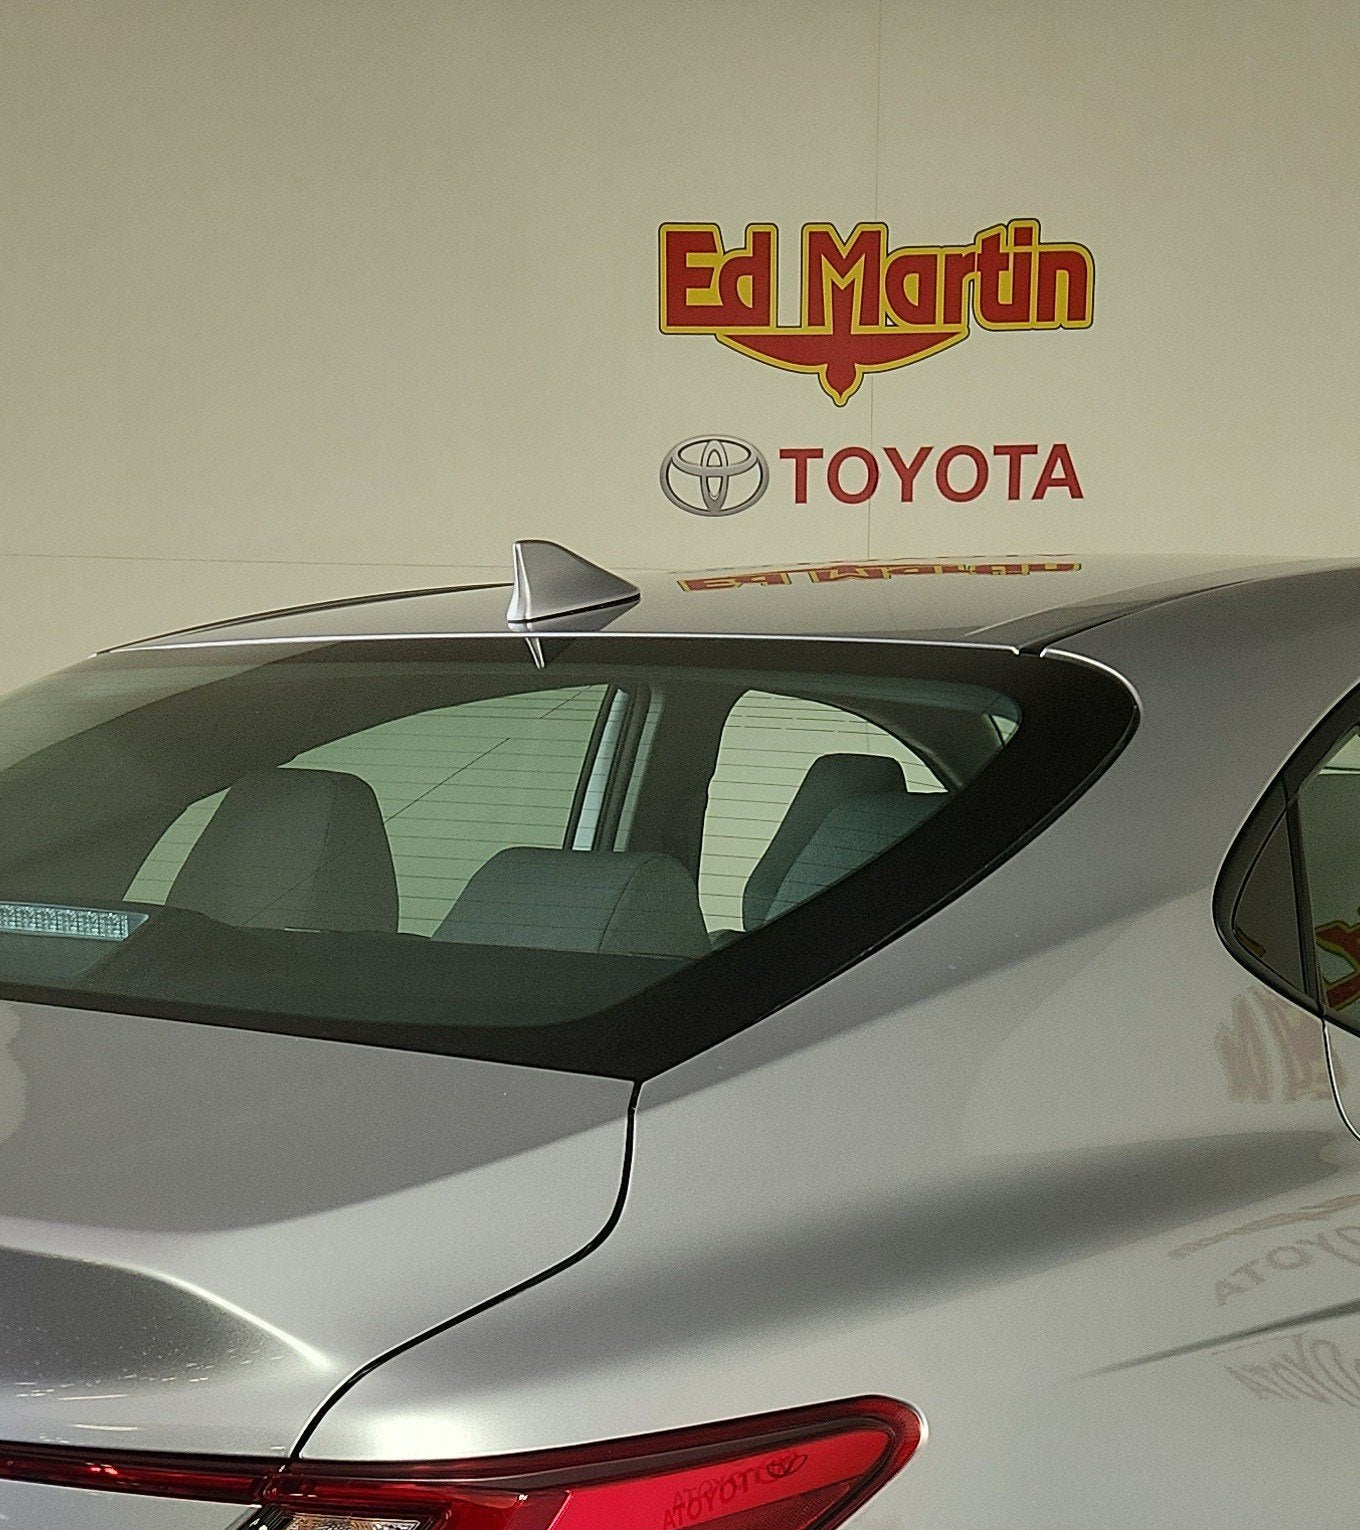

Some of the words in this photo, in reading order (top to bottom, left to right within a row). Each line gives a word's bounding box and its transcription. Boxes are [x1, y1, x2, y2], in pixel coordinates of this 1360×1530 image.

[661, 225, 776, 332] Ed
[803, 221, 1092, 328] Martin
[779, 443, 1084, 505] TOYOTA
